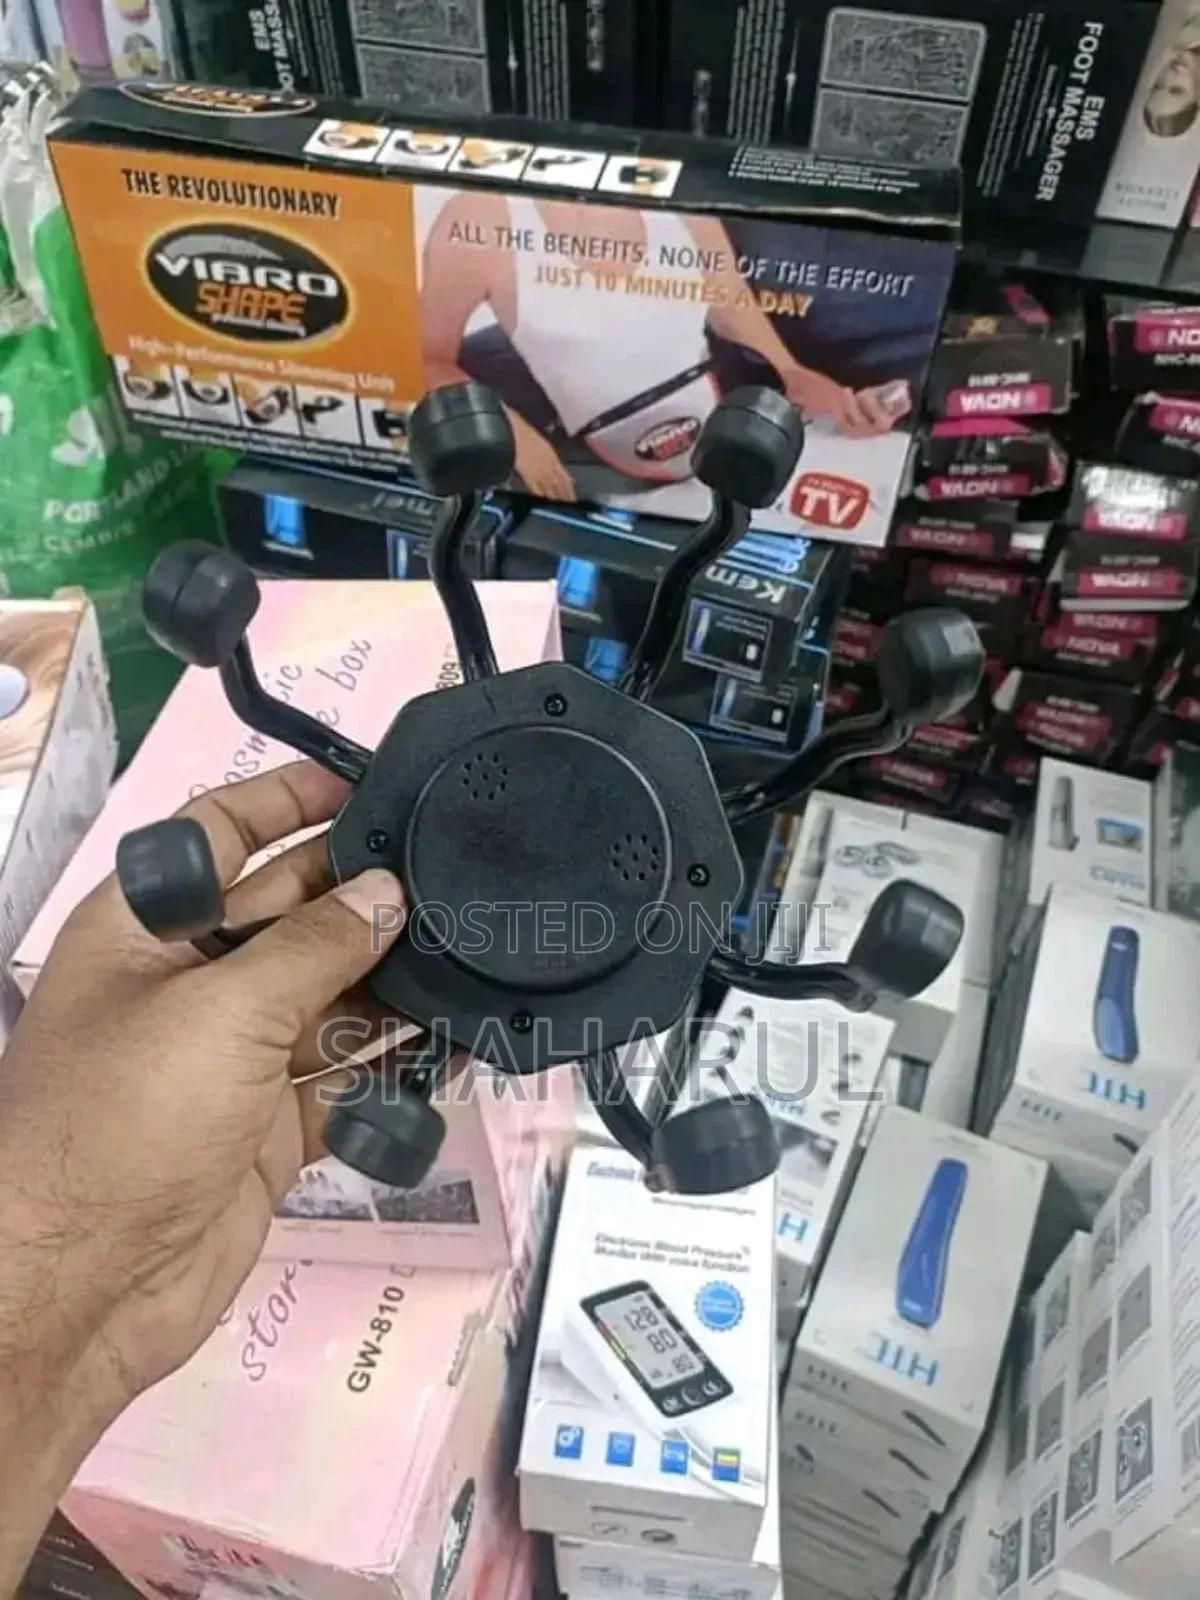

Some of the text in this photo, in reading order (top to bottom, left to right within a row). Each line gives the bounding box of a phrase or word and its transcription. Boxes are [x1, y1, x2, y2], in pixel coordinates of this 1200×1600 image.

[248, 9, 271, 51] EMS
[1070, 21, 1104, 84] FOOT
[1075, 96, 1105, 141] EMS
[1035, 86, 1085, 201] MASSAGER
[121, 168, 339, 218] THE REVOLUTIONARY
[155, 253, 339, 298] VIBRO
[449, 221, 916, 298] ALL THE BENEFITS, NONE OF THE EFFORT
[196, 282, 307, 324] SHAPE
[535, 264, 814, 318] JUST 10 MINUTES A DAY
[1167, 328, 1200, 346] NO
[960, 391, 1022, 413] NOVA
[800, 486, 860, 527] TV
[941, 480, 998, 497] NOVA
[705, 565, 787, 605] Kem
[1091, 573, 1150, 589] NOVA
[316, 639, 373, 693] box
[346, 1285, 405, 1394] GW-810
